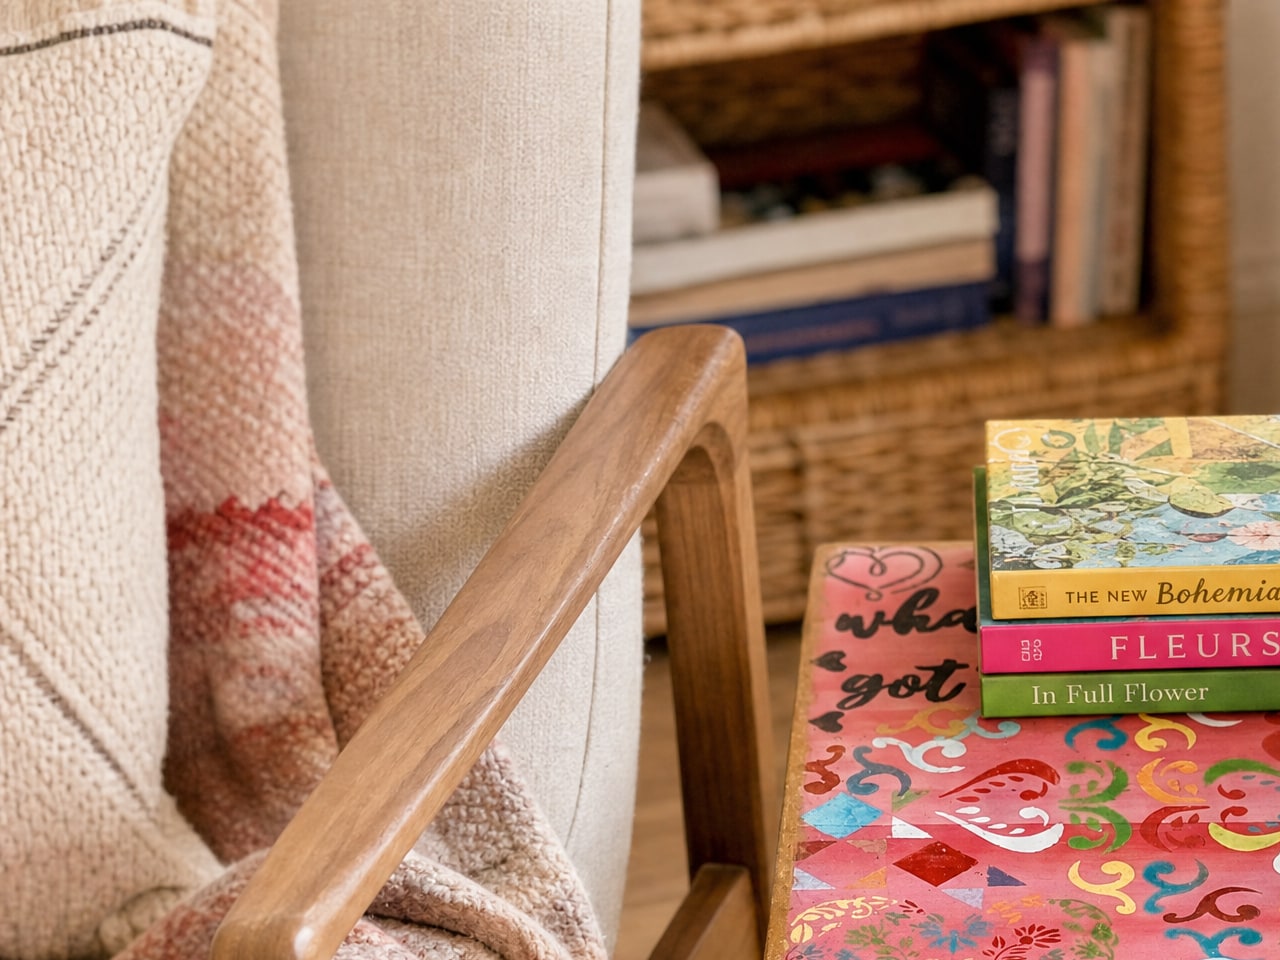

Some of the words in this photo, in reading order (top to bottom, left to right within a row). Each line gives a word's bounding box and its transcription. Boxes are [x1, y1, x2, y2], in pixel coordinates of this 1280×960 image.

[1065, 591, 1100, 604] THE
[1107, 589, 1148, 603] NEW
[834, 587, 977, 639] wha
[1110, 631, 1280, 660] FLEURS
[836, 658, 970, 710] got
[1031, 685, 1057, 705] In
[1066, 682, 1114, 704] Full
[1124, 682, 1209, 702] Flower
